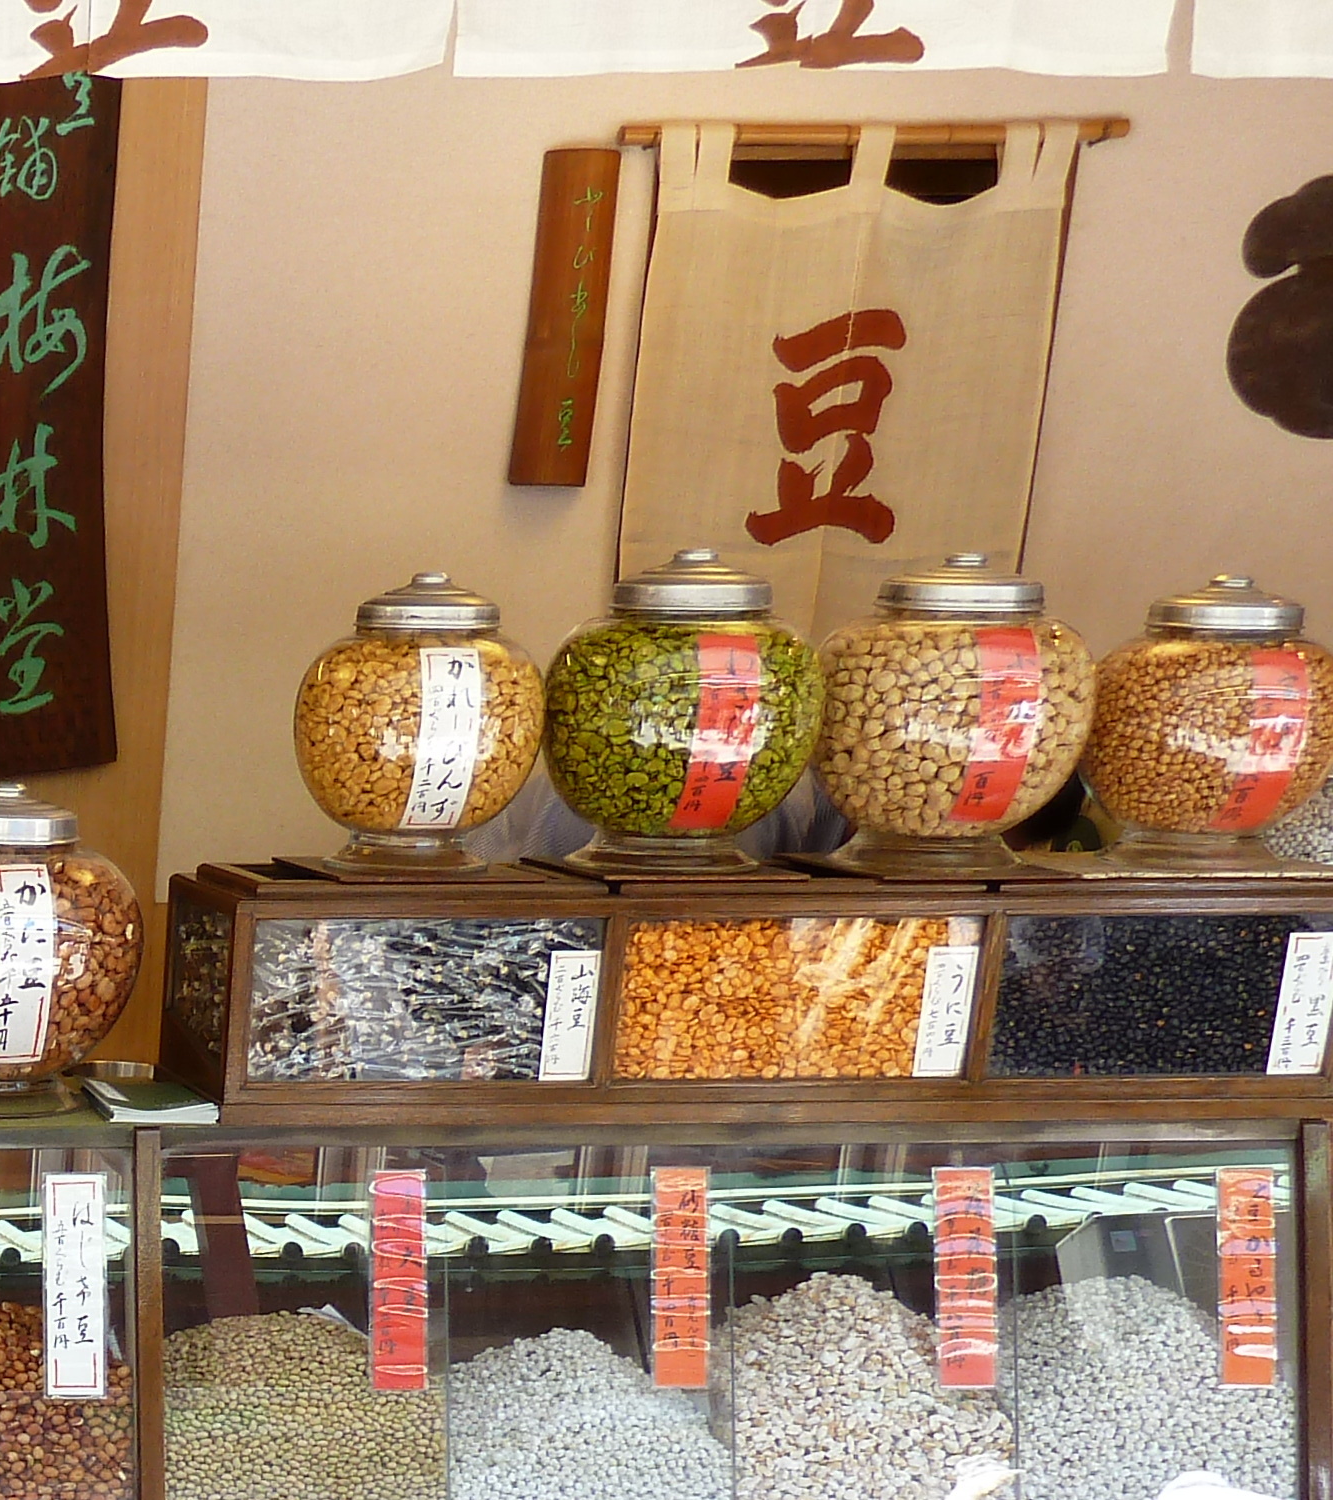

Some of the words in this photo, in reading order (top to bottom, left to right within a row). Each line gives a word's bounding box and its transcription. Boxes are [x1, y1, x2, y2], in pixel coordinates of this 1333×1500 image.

[745, 308, 908, 547] 豆
[937, 963, 964, 1047] うに豆
